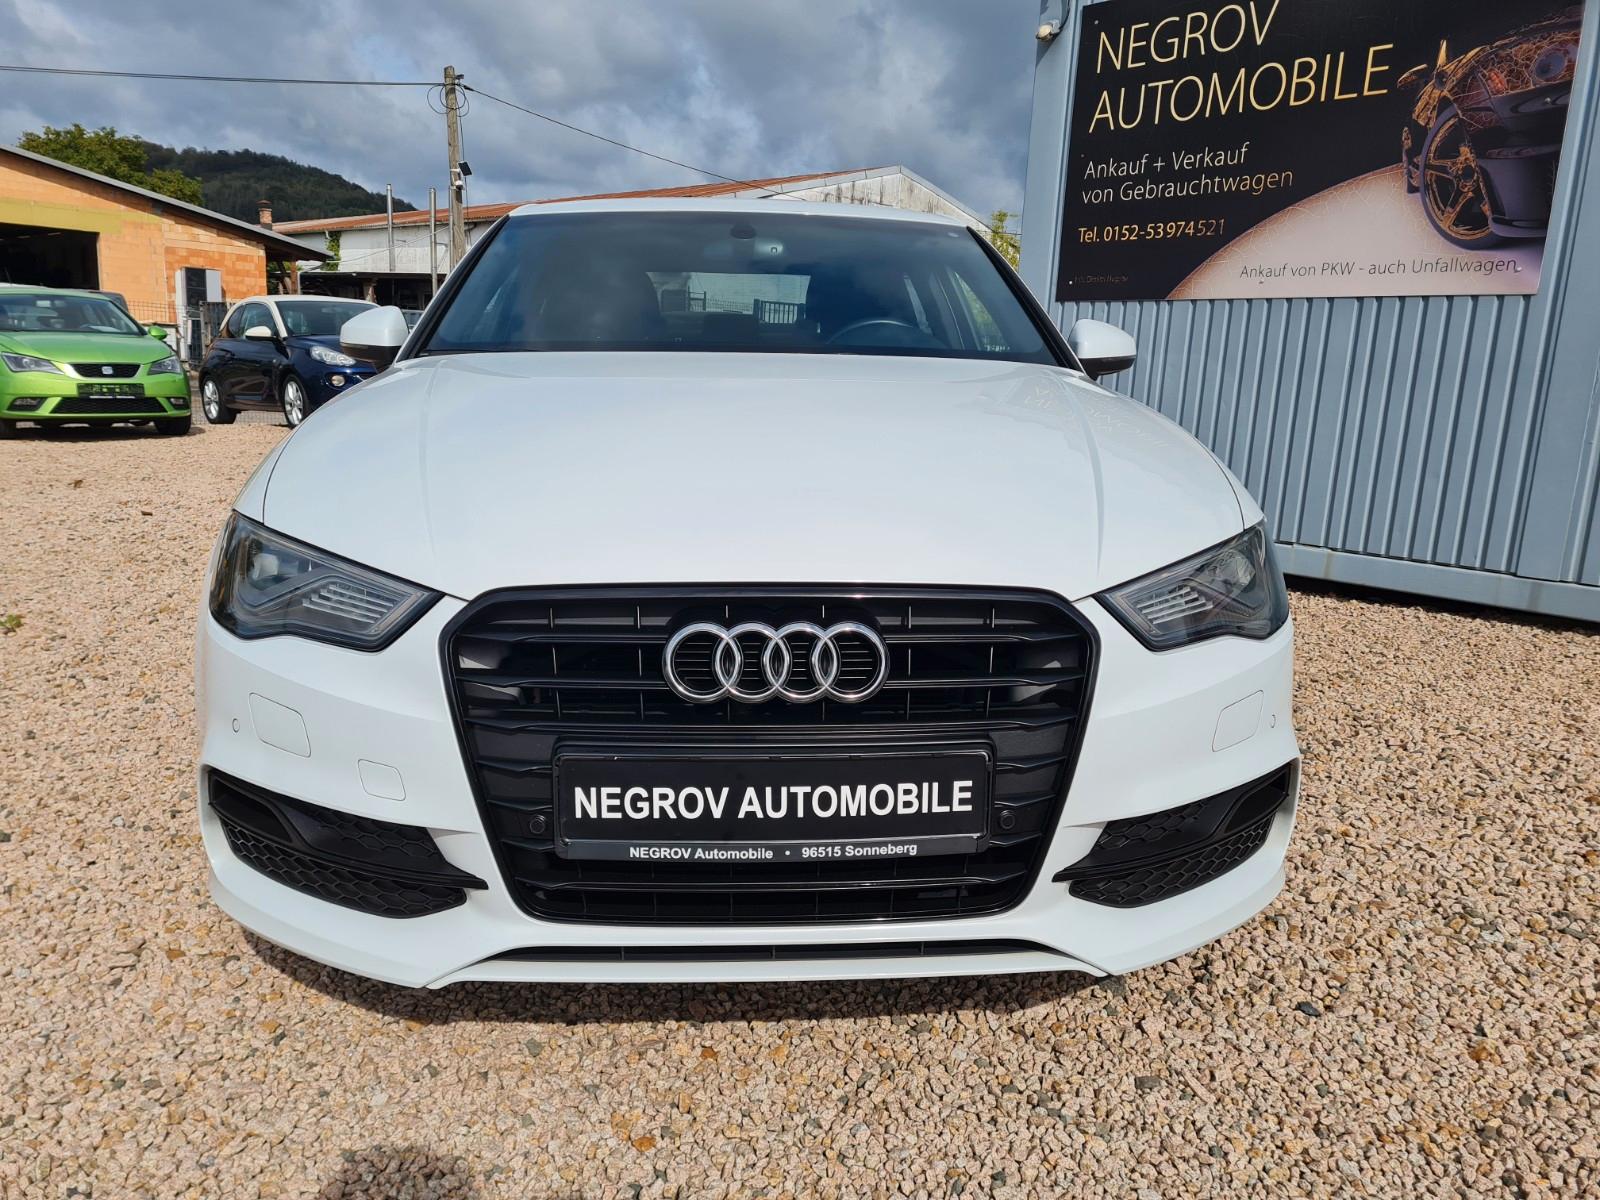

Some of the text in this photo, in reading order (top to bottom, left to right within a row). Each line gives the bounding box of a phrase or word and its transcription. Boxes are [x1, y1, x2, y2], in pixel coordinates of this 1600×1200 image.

[1096, 0, 1280, 74] NEGROV
[1088, 43, 1394, 133] AUTOMOBILE
[1084, 141, 1250, 180] Ankauf + Verkauf
[1082, 170, 1294, 204] von Gebrauchtwagen
[1078, 226, 1101, 243] Tel.
[1239, 262, 1288, 278] Ankauf
[1291, 265, 1316, 278] von
[1320, 261, 1356, 276] PKW
[1368, 258, 1406, 275] auch
[1411, 256, 1517, 275] Unfallwagen
[574, 780, 973, 819] NEGROV AUTOMOBILE
[629, 843, 918, 860] NEGROV Automobile 96515 Sonneberg
